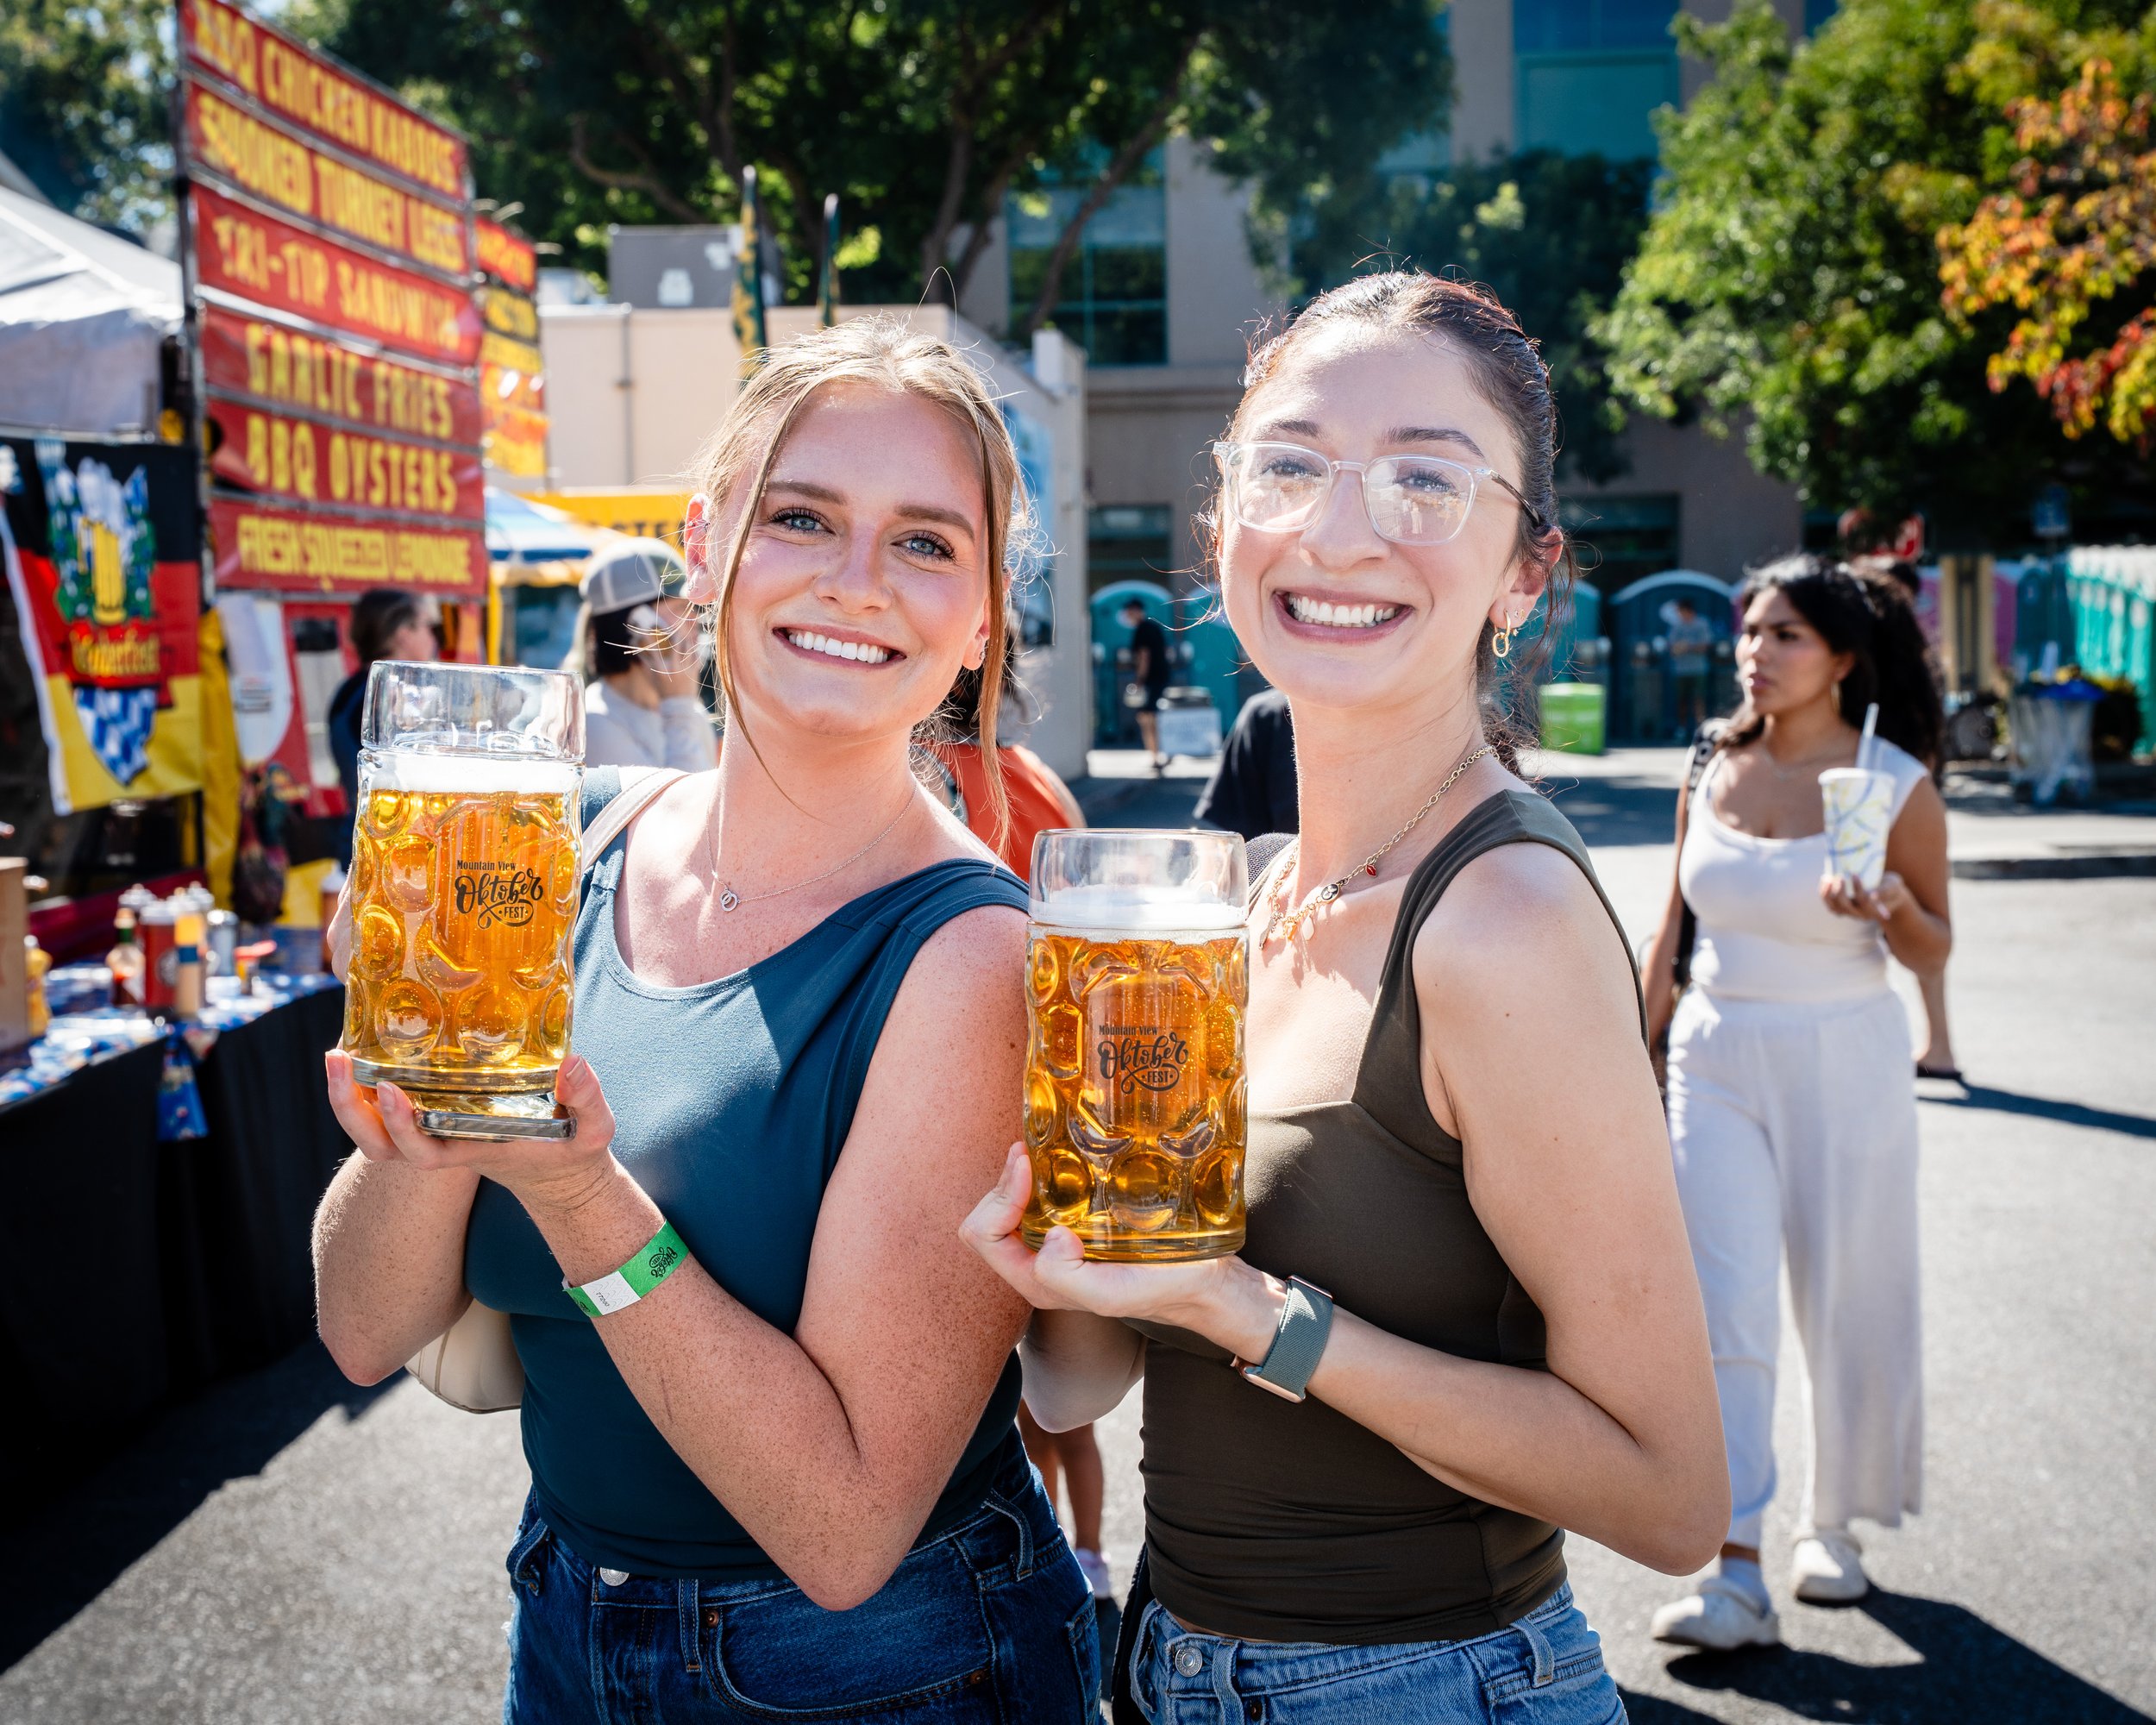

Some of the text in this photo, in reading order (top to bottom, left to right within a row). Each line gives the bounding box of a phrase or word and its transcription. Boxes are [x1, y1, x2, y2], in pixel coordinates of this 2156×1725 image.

[261, 36, 369, 151] CHICKEN
[212, 215, 329, 308] TRI-TIP
[246, 322, 362, 419] GARLIC
[373, 360, 454, 440] FRIES
[246, 414, 317, 501] BBQ
[329, 433, 458, 515] OYSTERS
[456, 859, 517, 871] Mountain View
[454, 868, 544, 914] Oktober
[504, 906, 525, 919] FEST
[1099, 1025, 1158, 1036] Mountain View
[1097, 1032, 1189, 1079] Oktober
[1147, 1070, 1169, 1083] FEST
